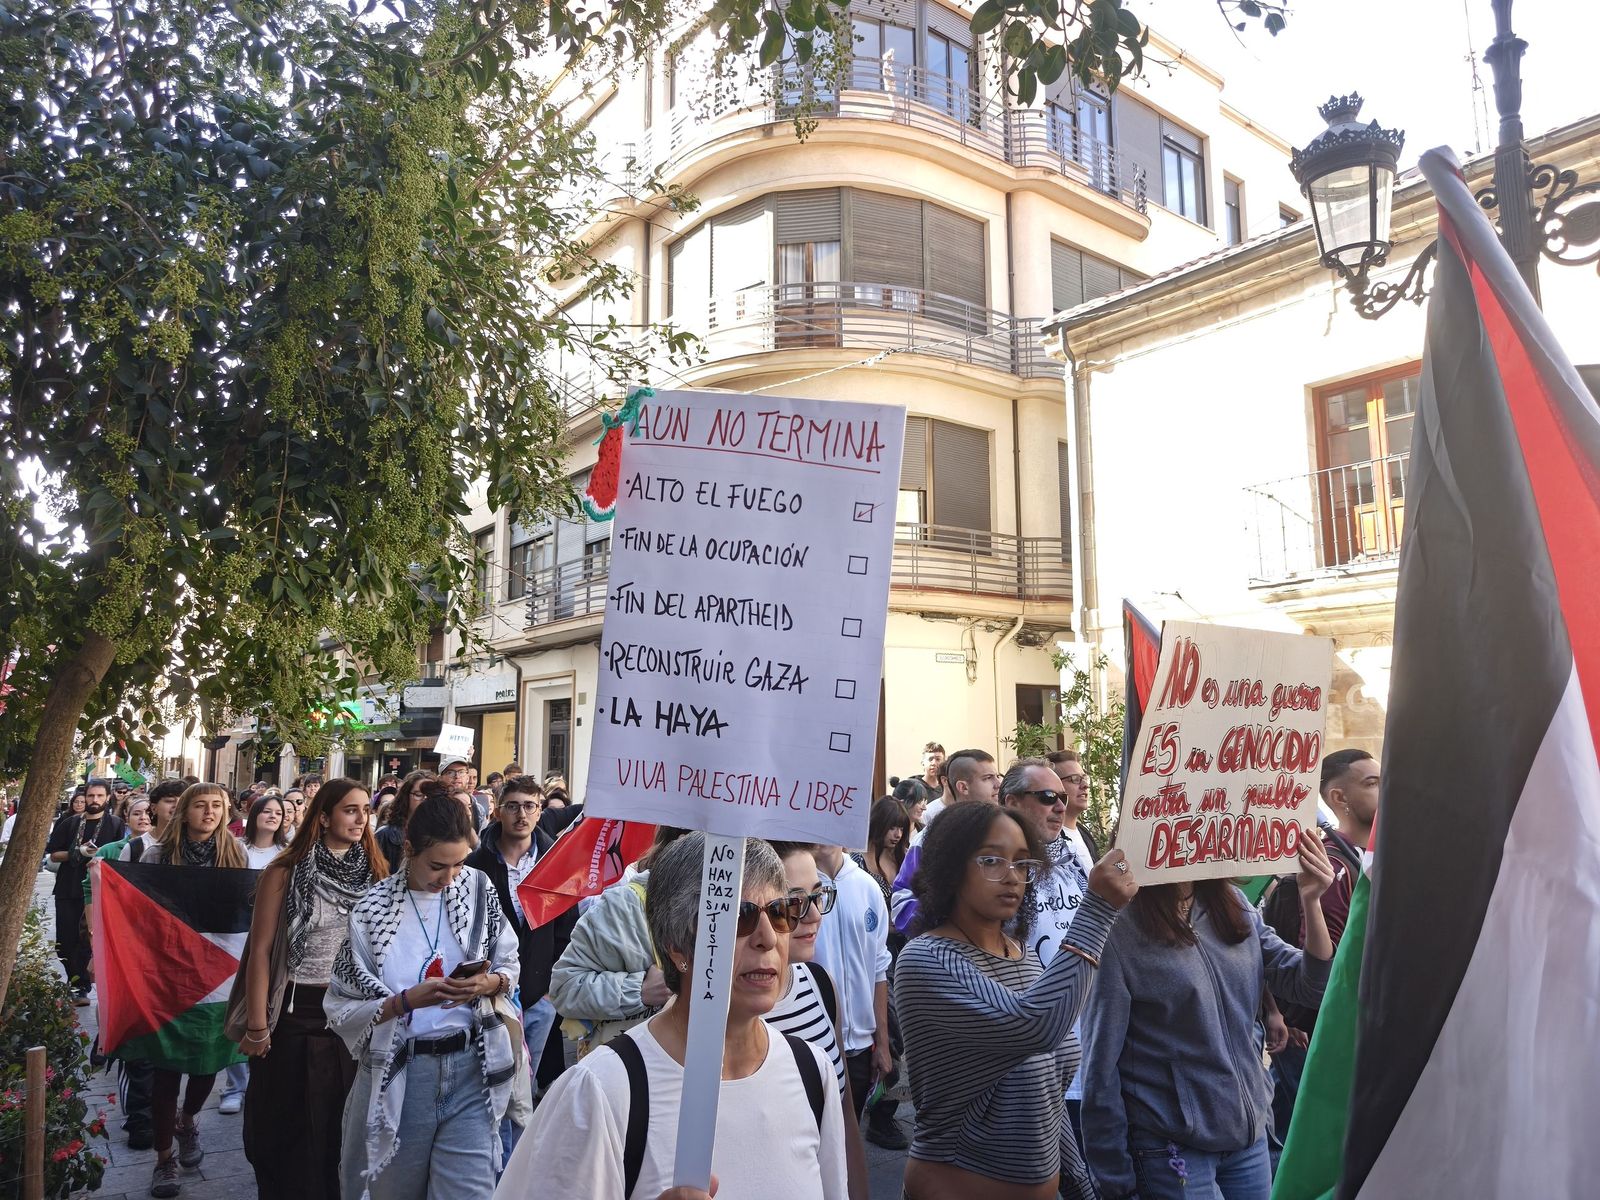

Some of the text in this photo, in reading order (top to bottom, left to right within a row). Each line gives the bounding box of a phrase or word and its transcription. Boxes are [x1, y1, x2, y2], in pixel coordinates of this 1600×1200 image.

[707, 408, 746, 447] NO
[757, 410, 885, 463] TERMINA
[628, 472, 802, 514] ALTO EL FUEGO
[625, 528, 810, 568] FIN DE LA OCUPACIÓN
[654, 590, 687, 618] DEL
[694, 594, 793, 631] APARTHEID
[745, 656, 809, 694] GAZA
[1156, 635, 1202, 711] NO
[1222, 678, 1268, 709] una
[610, 696, 729, 738] LA HAYA
[1140, 722, 1182, 777] ES
[1216, 724, 1321, 774] GENOCIDIO
[617, 758, 858, 816] VIVA PALESTINA LIBRE
[1197, 787, 1231, 814] un
[710, 844, 735, 864] NO
[1145, 813, 1301, 870] DESARMADO
[708, 883, 734, 898] PAZ
[709, 867, 733, 883] HAY
[706, 900, 730, 912] SIN
[703, 911, 721, 1000] JUSTICIA
